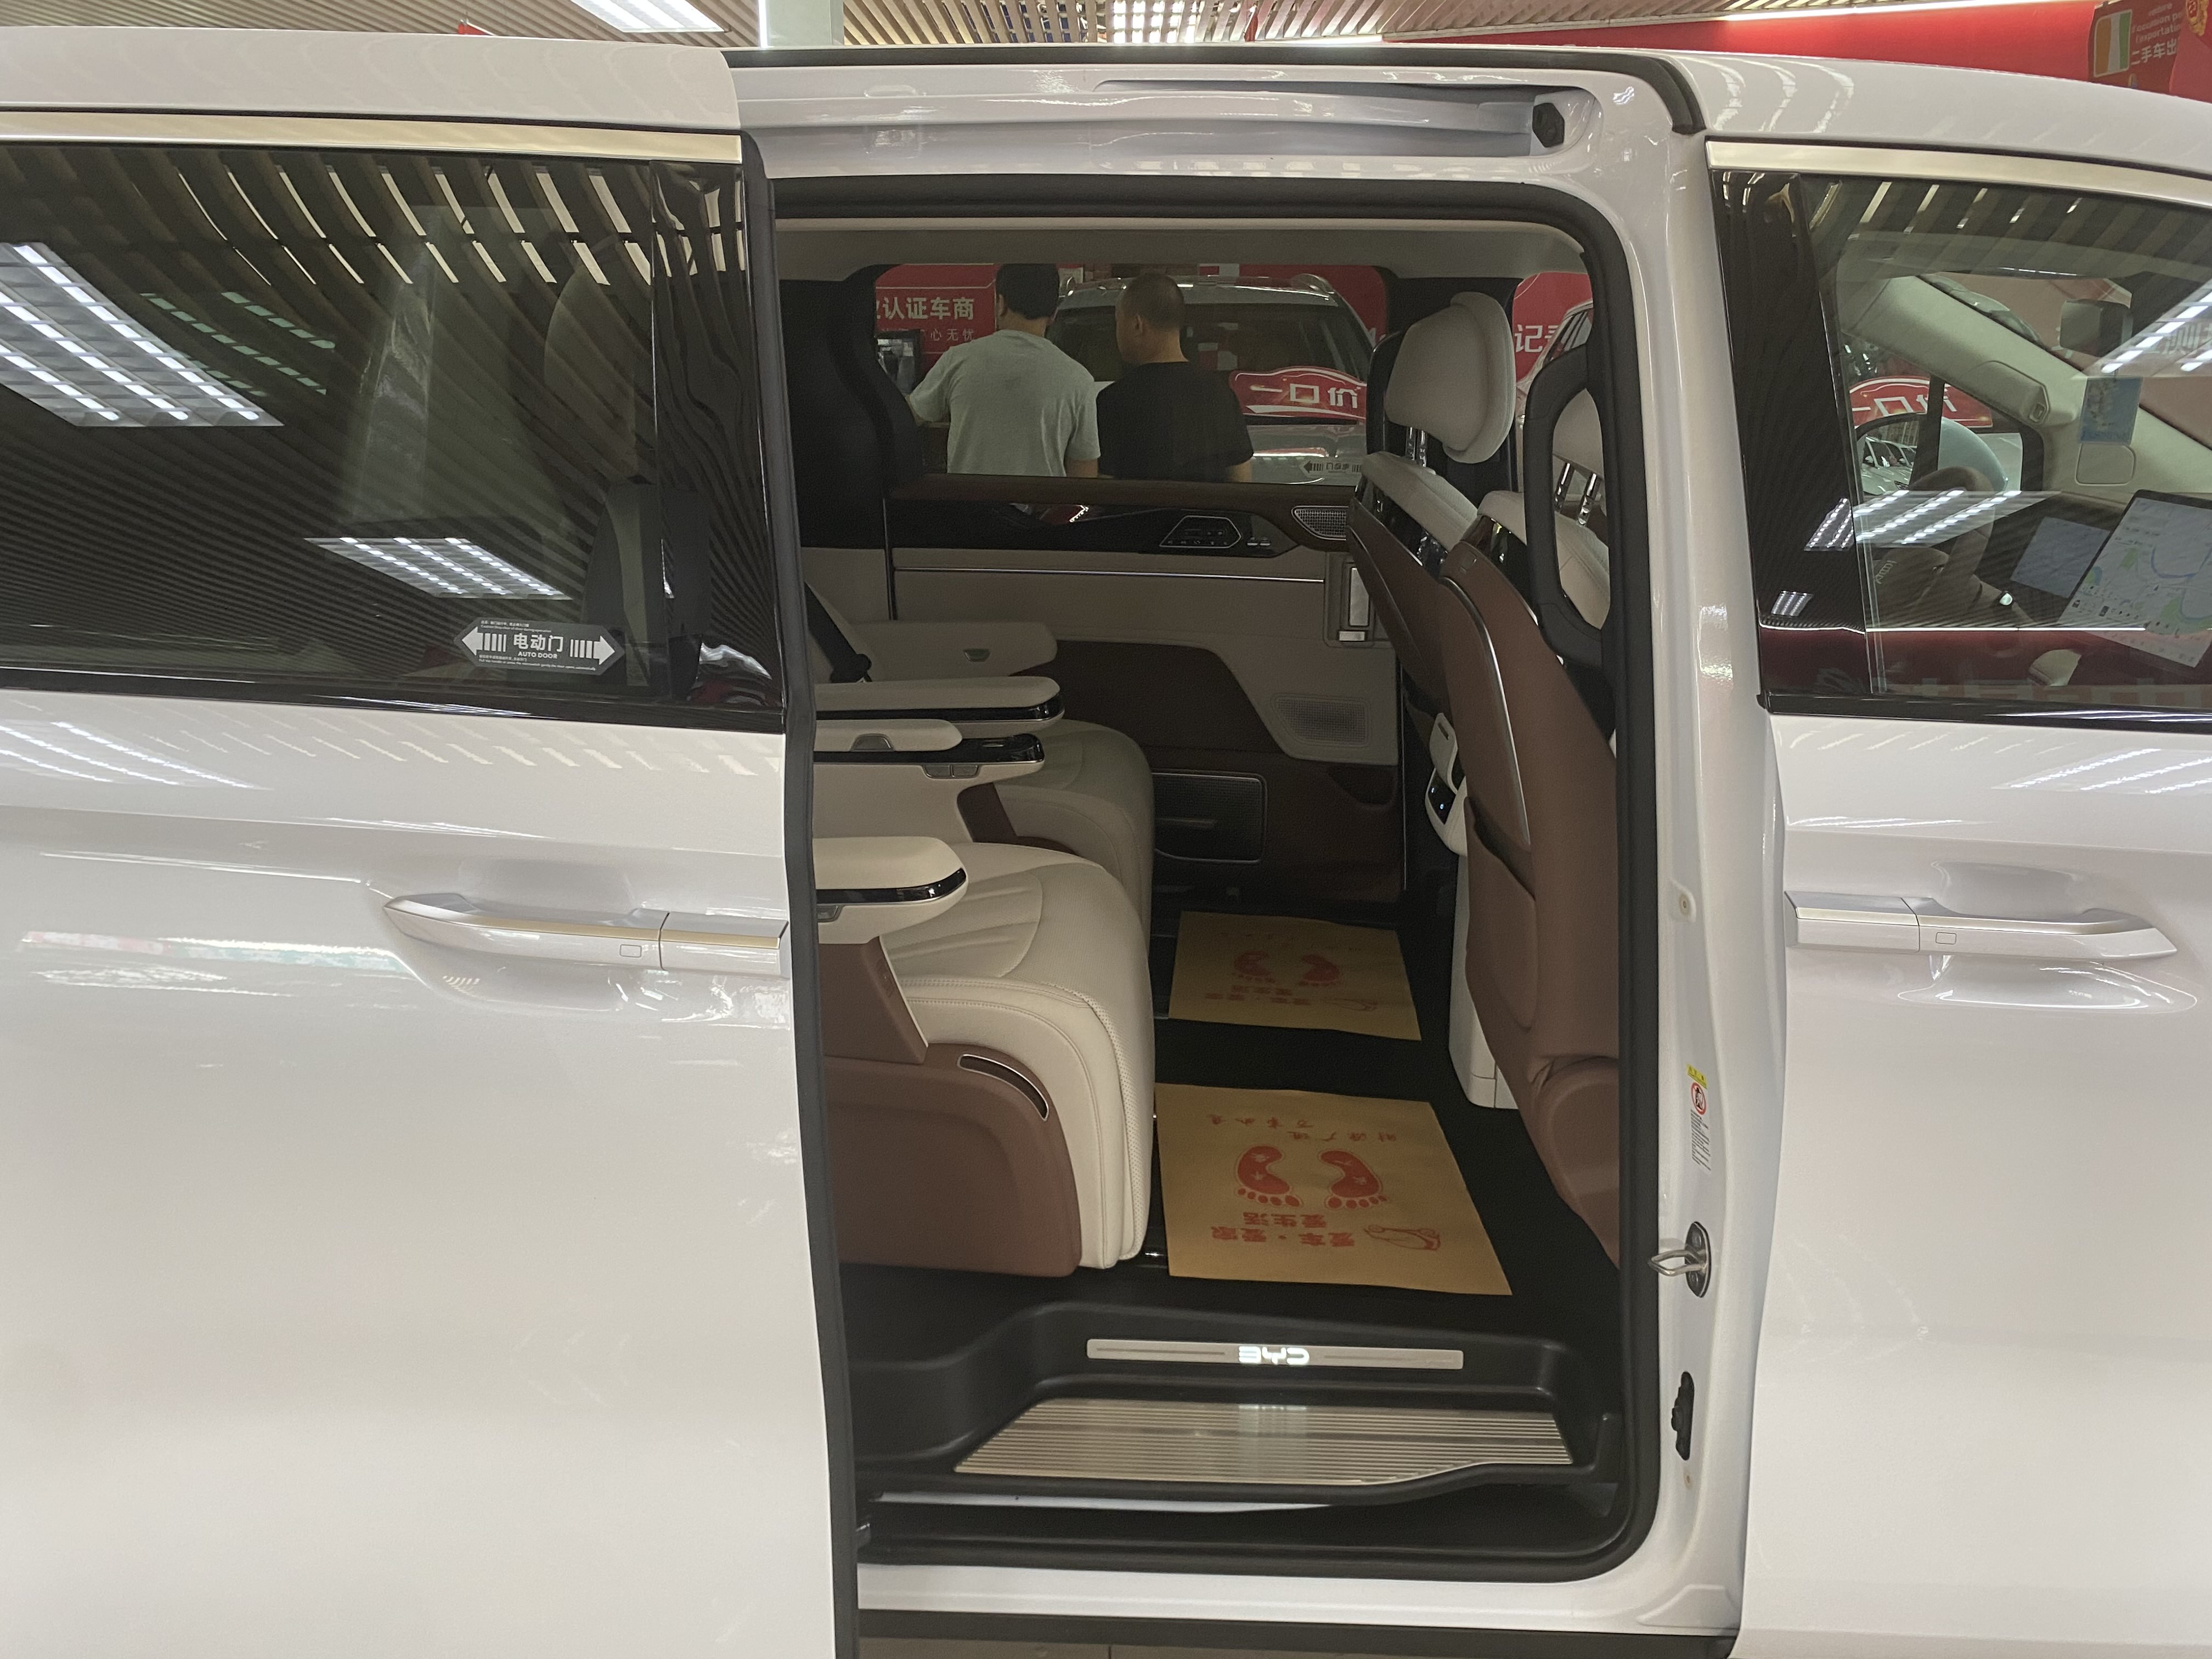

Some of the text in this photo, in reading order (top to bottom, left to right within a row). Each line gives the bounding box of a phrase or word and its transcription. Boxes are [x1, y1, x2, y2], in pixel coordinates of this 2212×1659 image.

[2131, 37, 2177, 65] 二手车出
[1249, 383, 1358, 409] 一口价
[513, 633, 564, 652] 电动门
[1238, 1346, 1310, 1365] BYD
